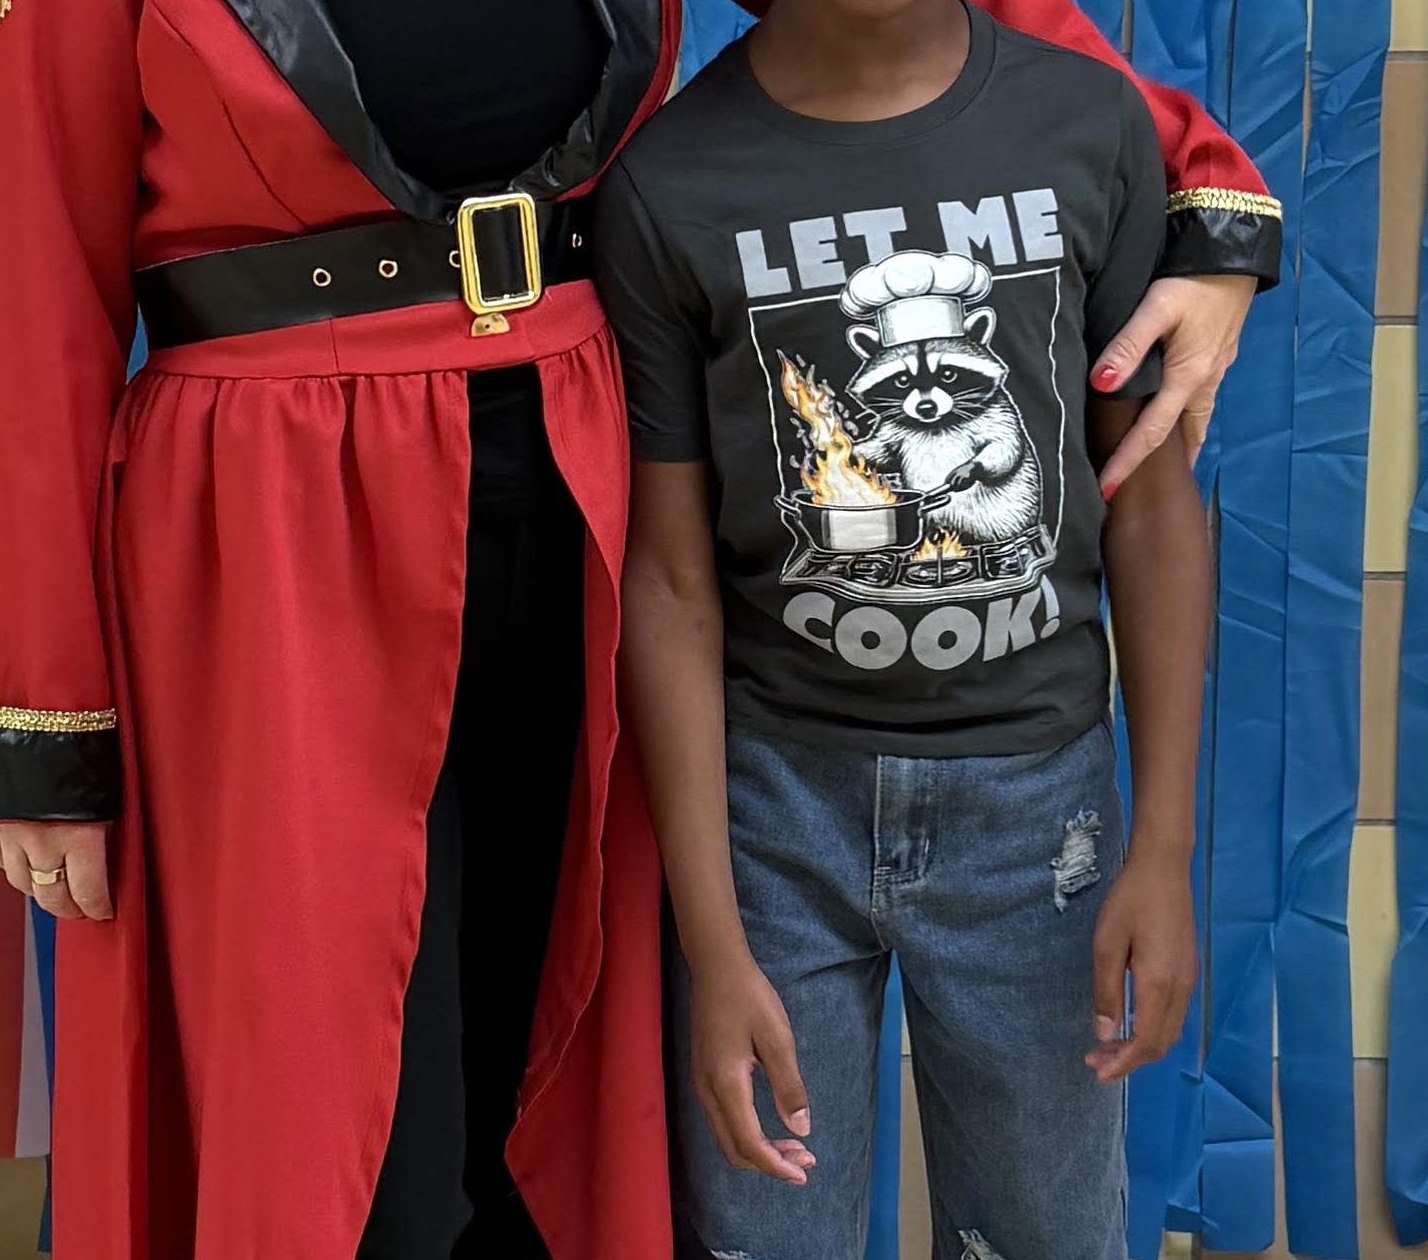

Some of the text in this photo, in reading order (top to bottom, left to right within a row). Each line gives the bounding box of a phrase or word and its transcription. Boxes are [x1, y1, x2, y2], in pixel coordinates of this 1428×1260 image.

[735, 187, 1065, 298] LET ME
[782, 574, 1061, 671] COOK!
